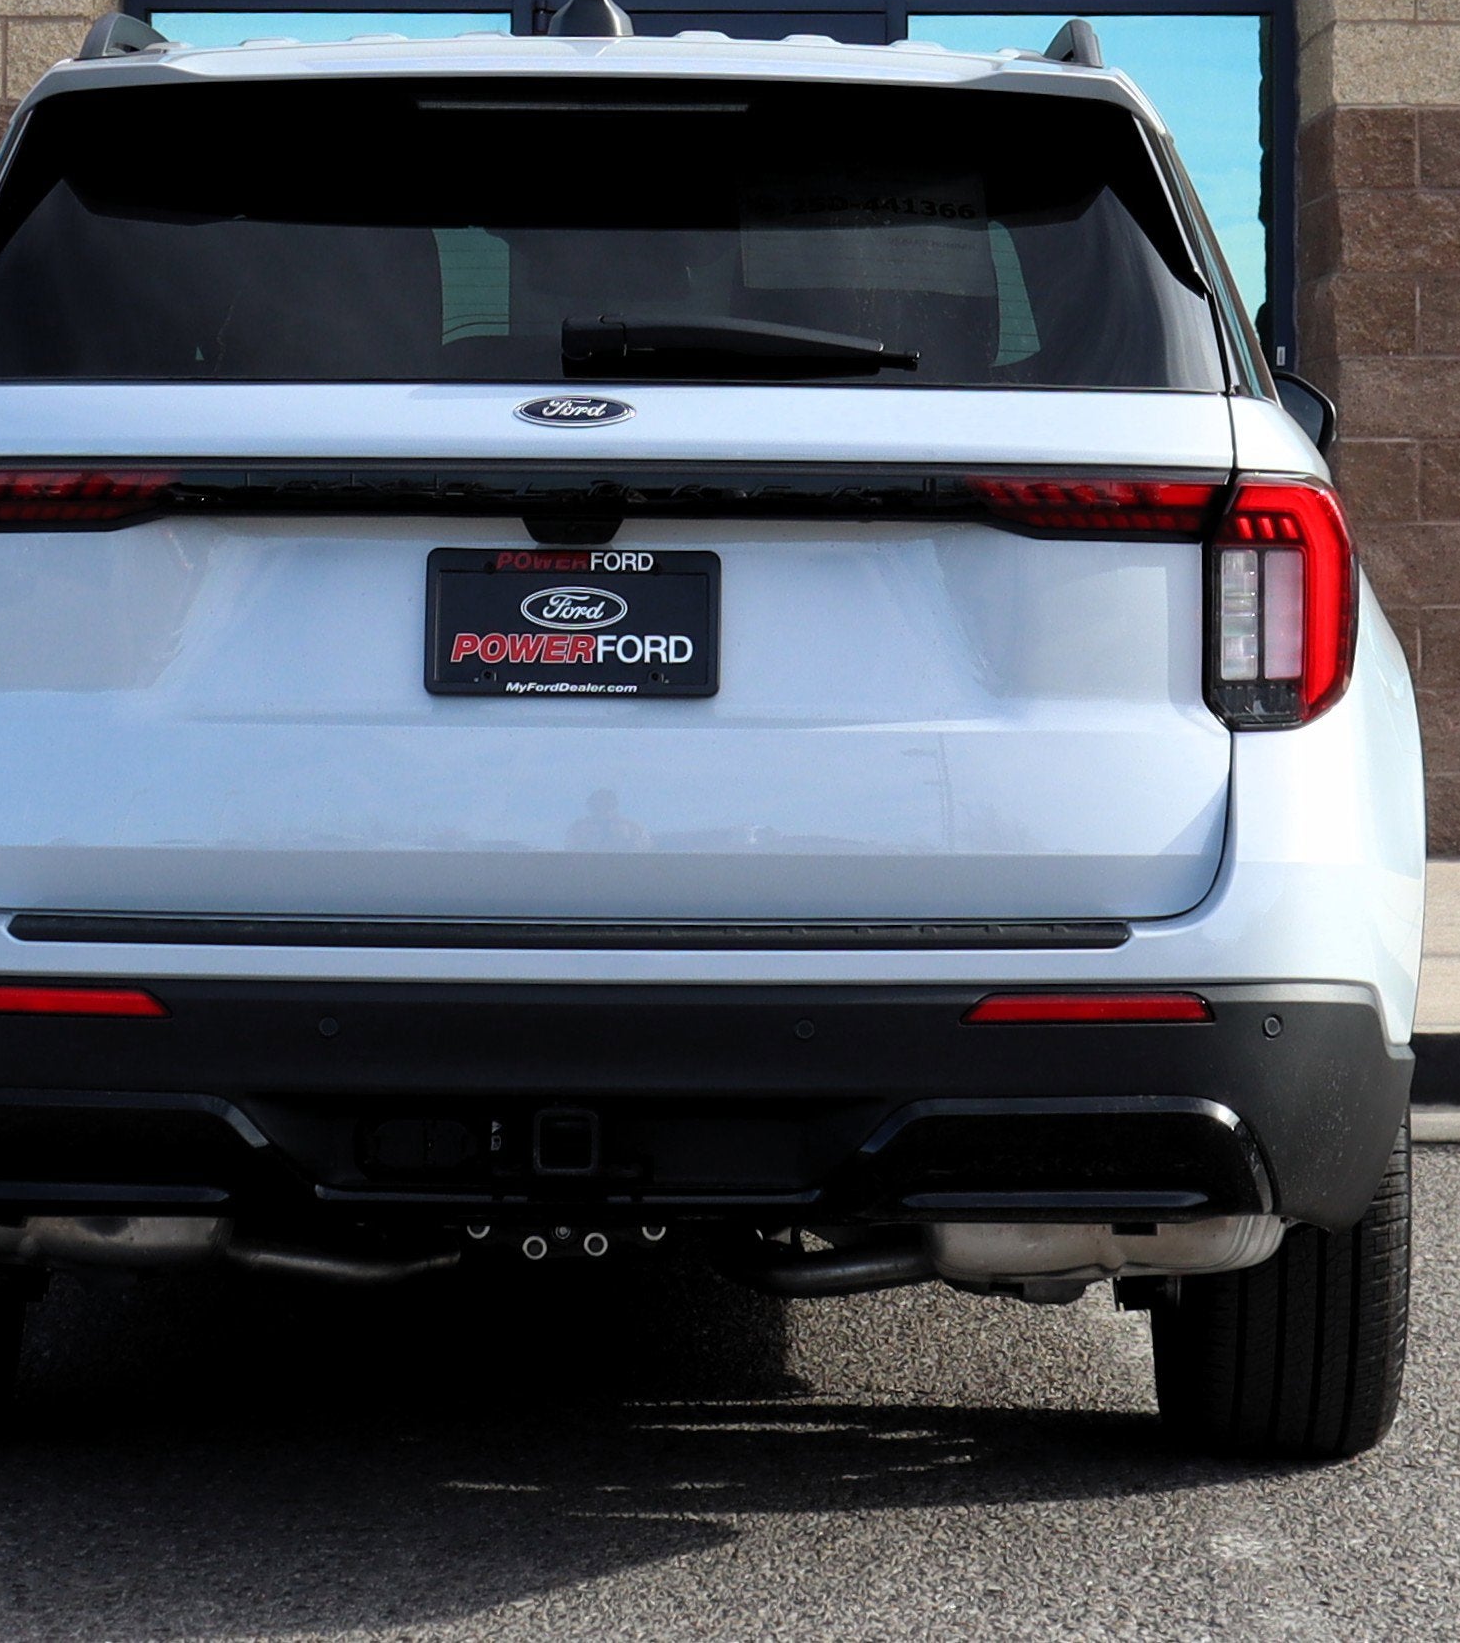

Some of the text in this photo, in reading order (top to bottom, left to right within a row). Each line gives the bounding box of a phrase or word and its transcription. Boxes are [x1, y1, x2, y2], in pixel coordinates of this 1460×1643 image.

[541, 399, 606, 418] Ford
[496, 551, 654, 572] POWERFORD
[542, 594, 606, 620] Ford
[450, 633, 693, 664] POWERFORD
[505, 681, 638, 694] MyFordDealer.com
